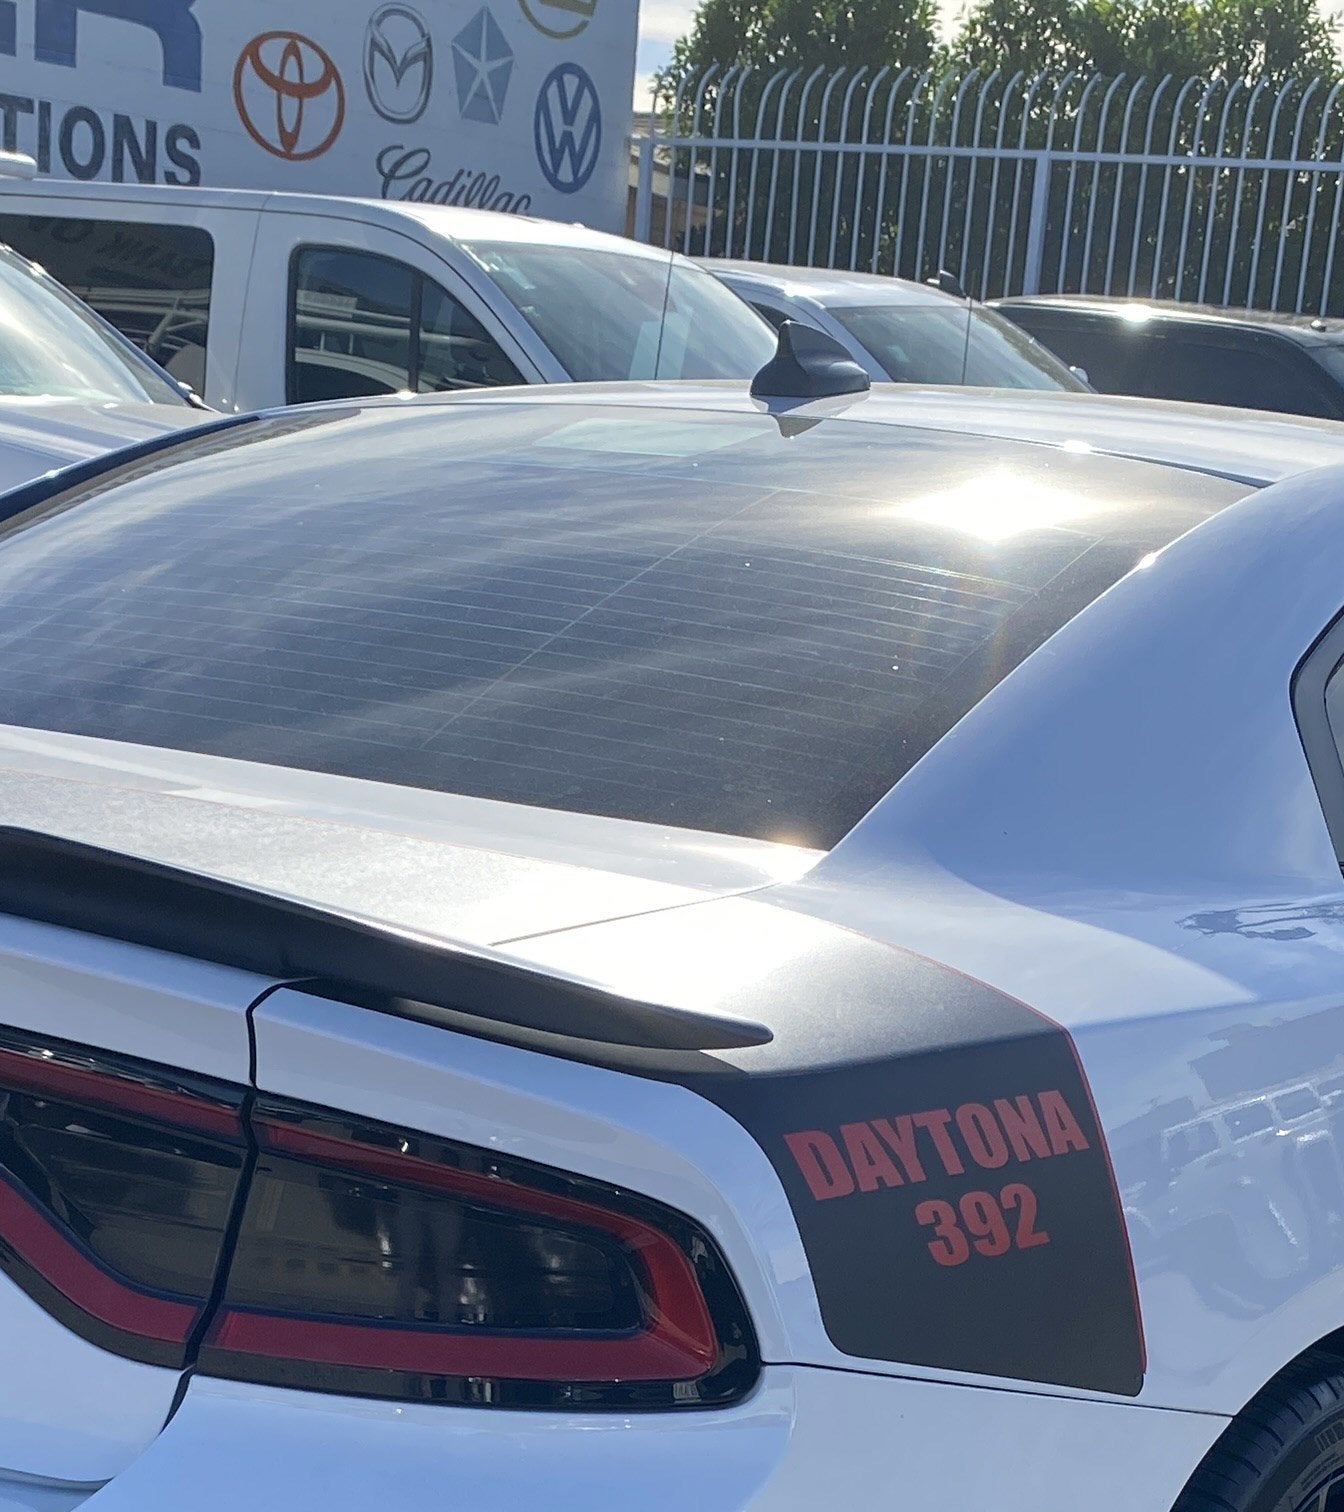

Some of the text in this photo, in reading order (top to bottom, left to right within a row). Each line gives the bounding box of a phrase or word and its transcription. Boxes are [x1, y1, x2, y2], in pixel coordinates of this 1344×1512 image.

[376, 145, 532, 216] Cadillac
[783, 1090, 1090, 1201] DAYTONA
[915, 1183, 1050, 1268] 392
